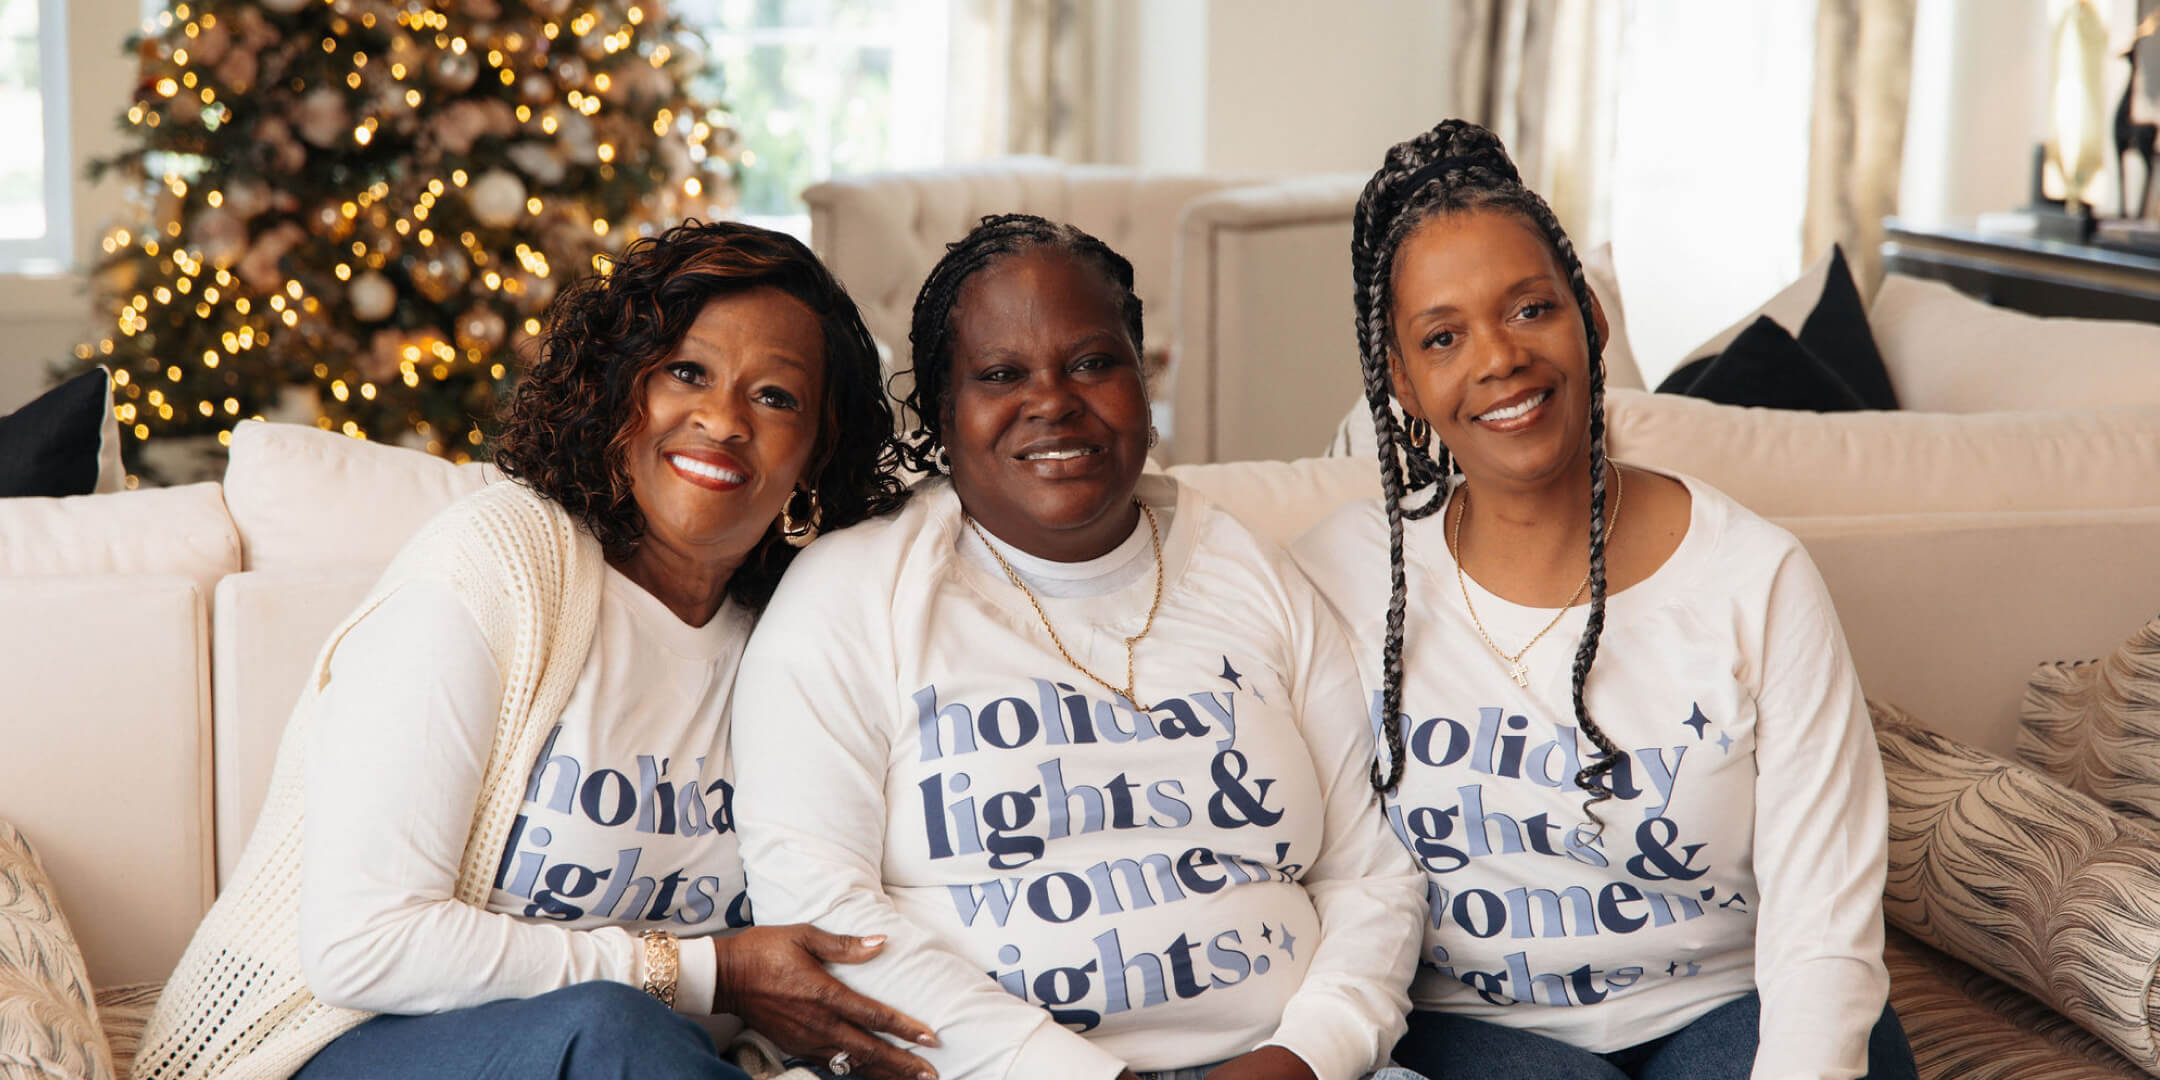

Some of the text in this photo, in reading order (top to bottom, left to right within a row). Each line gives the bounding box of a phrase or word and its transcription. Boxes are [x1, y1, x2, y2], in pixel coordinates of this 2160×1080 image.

[912, 677, 1235, 762] holiday
[524, 725, 736, 837] holida
[918, 749, 1285, 870] lights &
[1377, 774, 1711, 880] ghts &
[493, 813, 719, 925] lights
[1428, 880, 1748, 938] omen'
[986, 927, 1271, 1034] ights.
